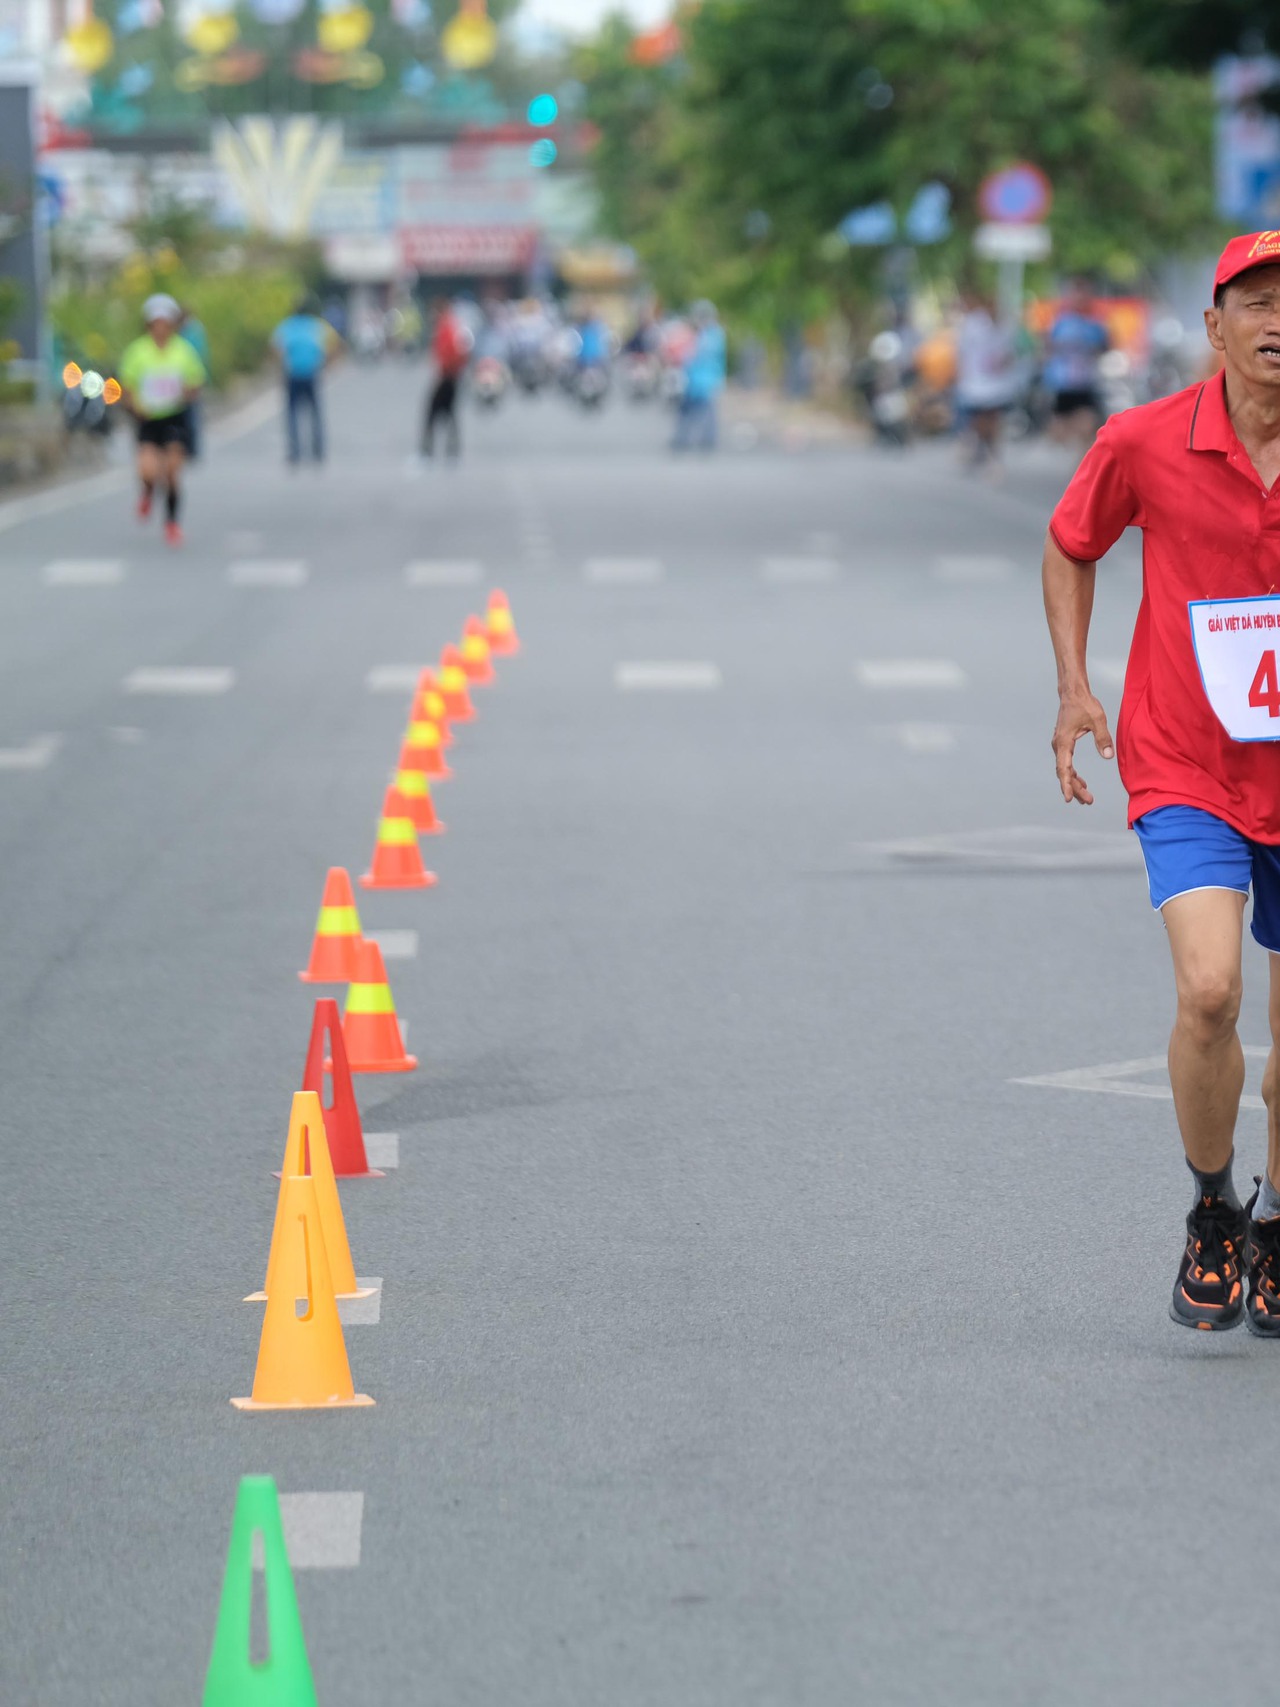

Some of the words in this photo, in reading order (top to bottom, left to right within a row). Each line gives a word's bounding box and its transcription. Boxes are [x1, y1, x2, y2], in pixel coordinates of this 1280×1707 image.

[1208, 614, 1222, 632] GIẢI
[1224, 614, 1240, 633] VIỆT
[1254, 612, 1276, 630] HUYỆN
